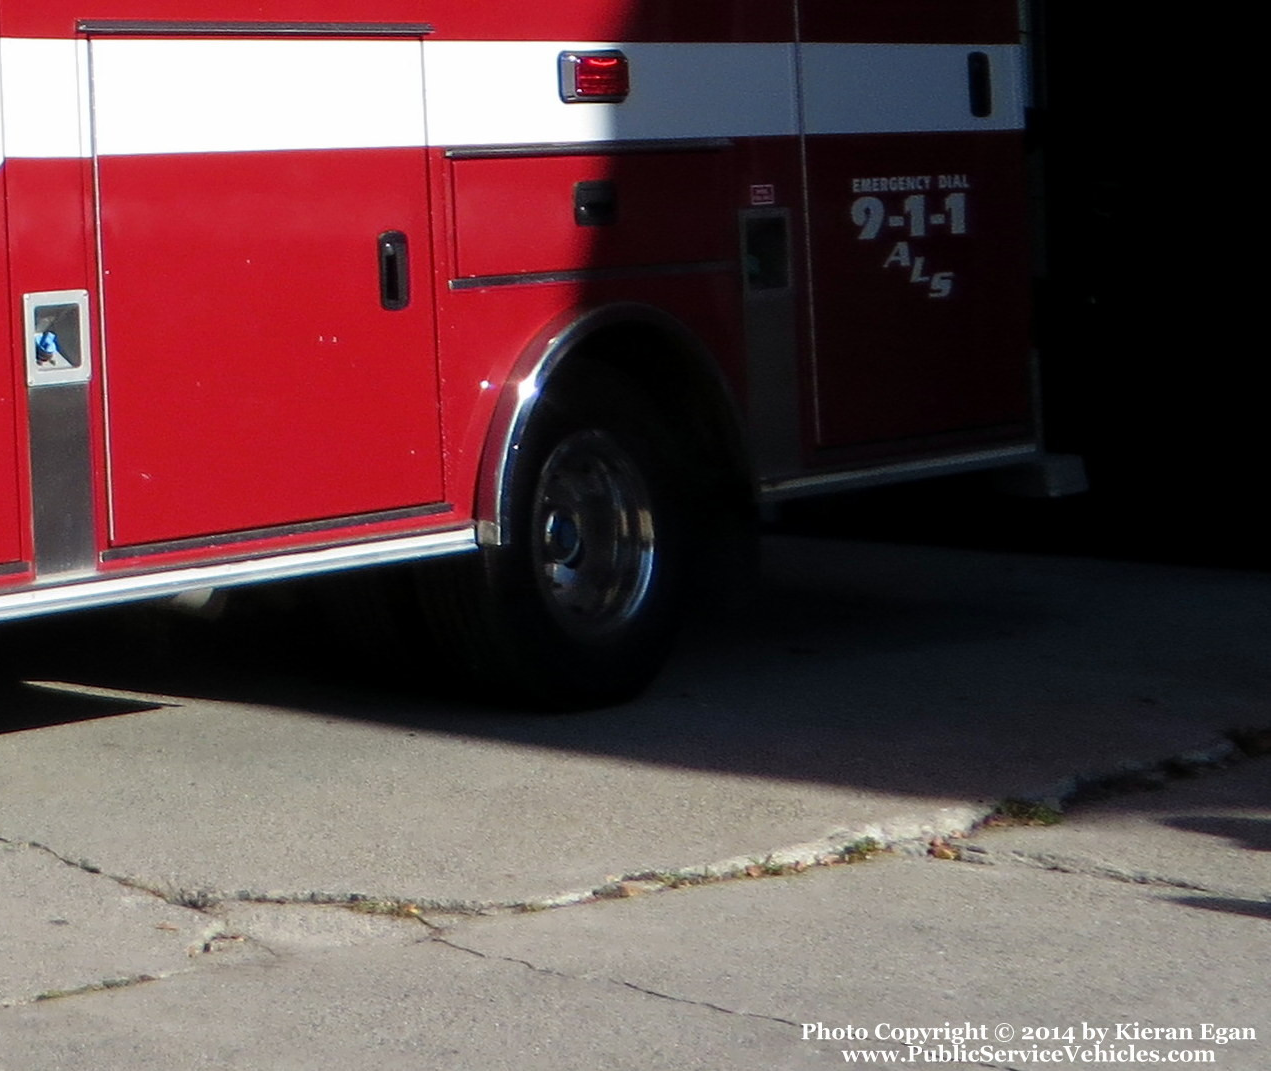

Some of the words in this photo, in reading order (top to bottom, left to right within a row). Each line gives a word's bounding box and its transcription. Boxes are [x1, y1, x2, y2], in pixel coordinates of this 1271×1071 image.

[852, 176, 932, 192] EMERGENCY
[938, 174, 970, 189] DIAL
[851, 193, 967, 240] 9-1-1
[883, 241, 956, 297] ALS
